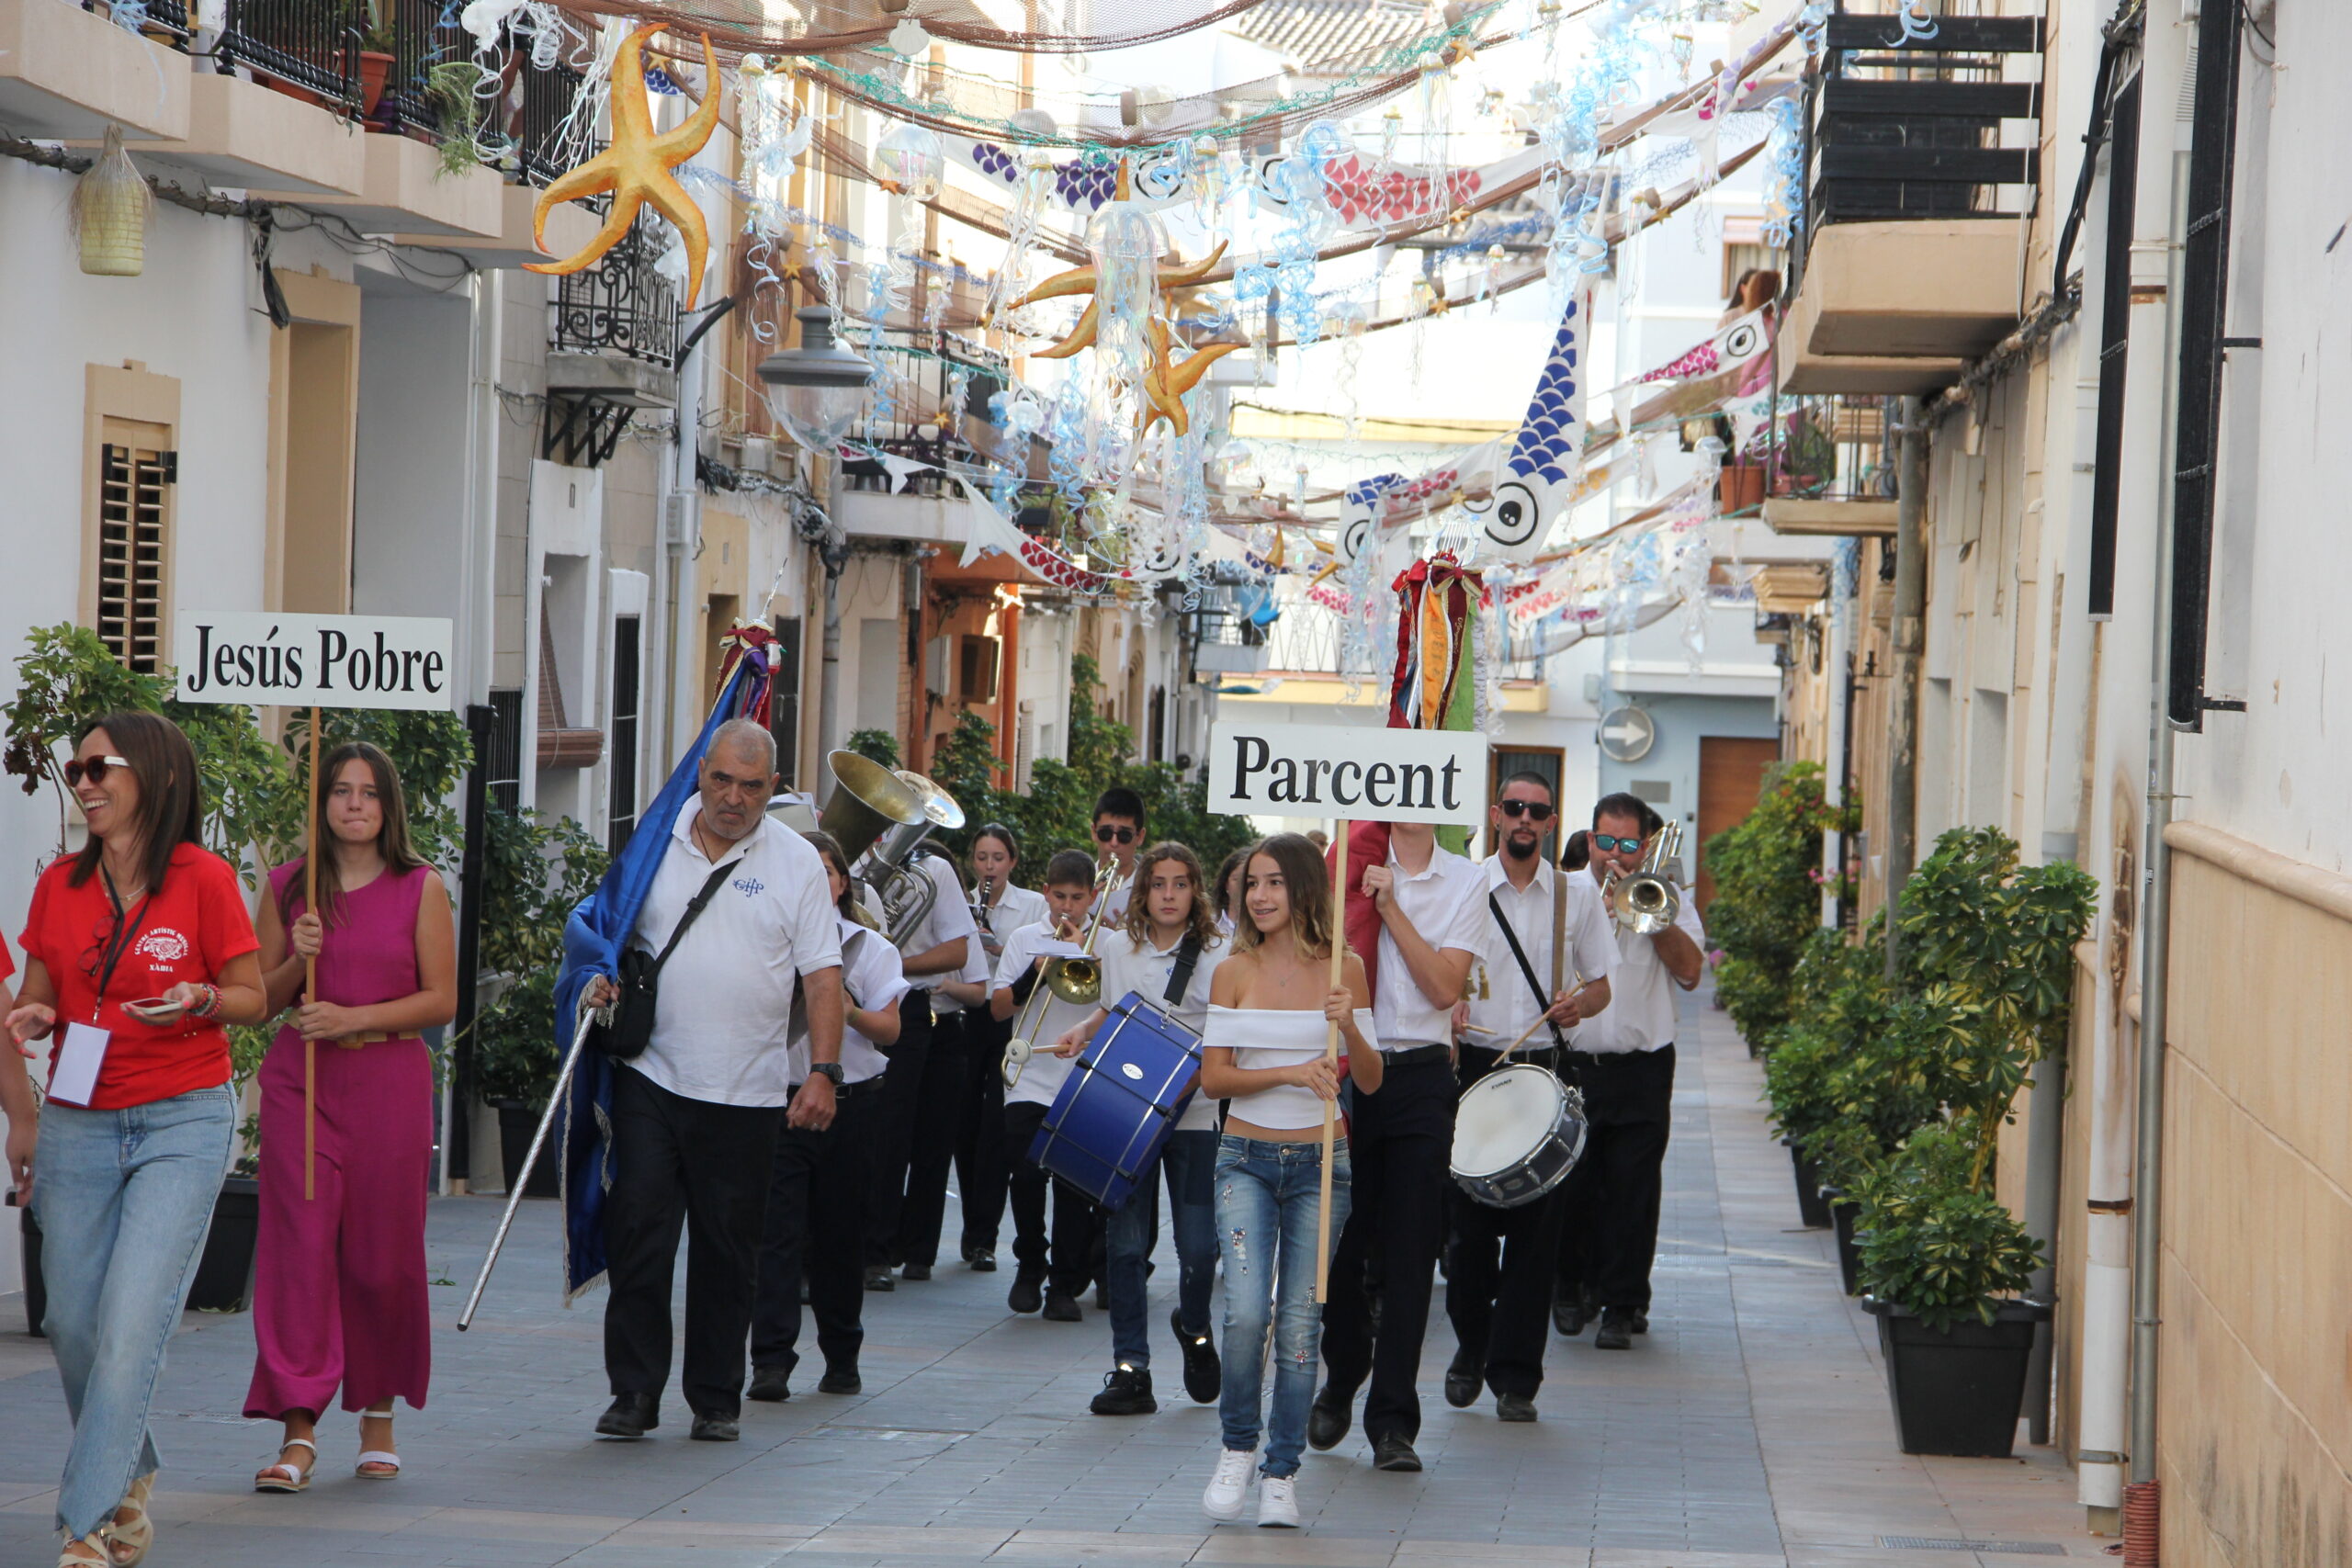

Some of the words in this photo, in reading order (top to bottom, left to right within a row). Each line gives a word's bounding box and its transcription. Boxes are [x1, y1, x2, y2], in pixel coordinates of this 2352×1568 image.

[187, 625, 302, 693] Jesús
[316, 629, 443, 694] Pobre
[1230, 736, 1462, 810] Parcent
[150, 926, 176, 936] ARTÍSTIC
[149, 963, 174, 973] XÀBIA
